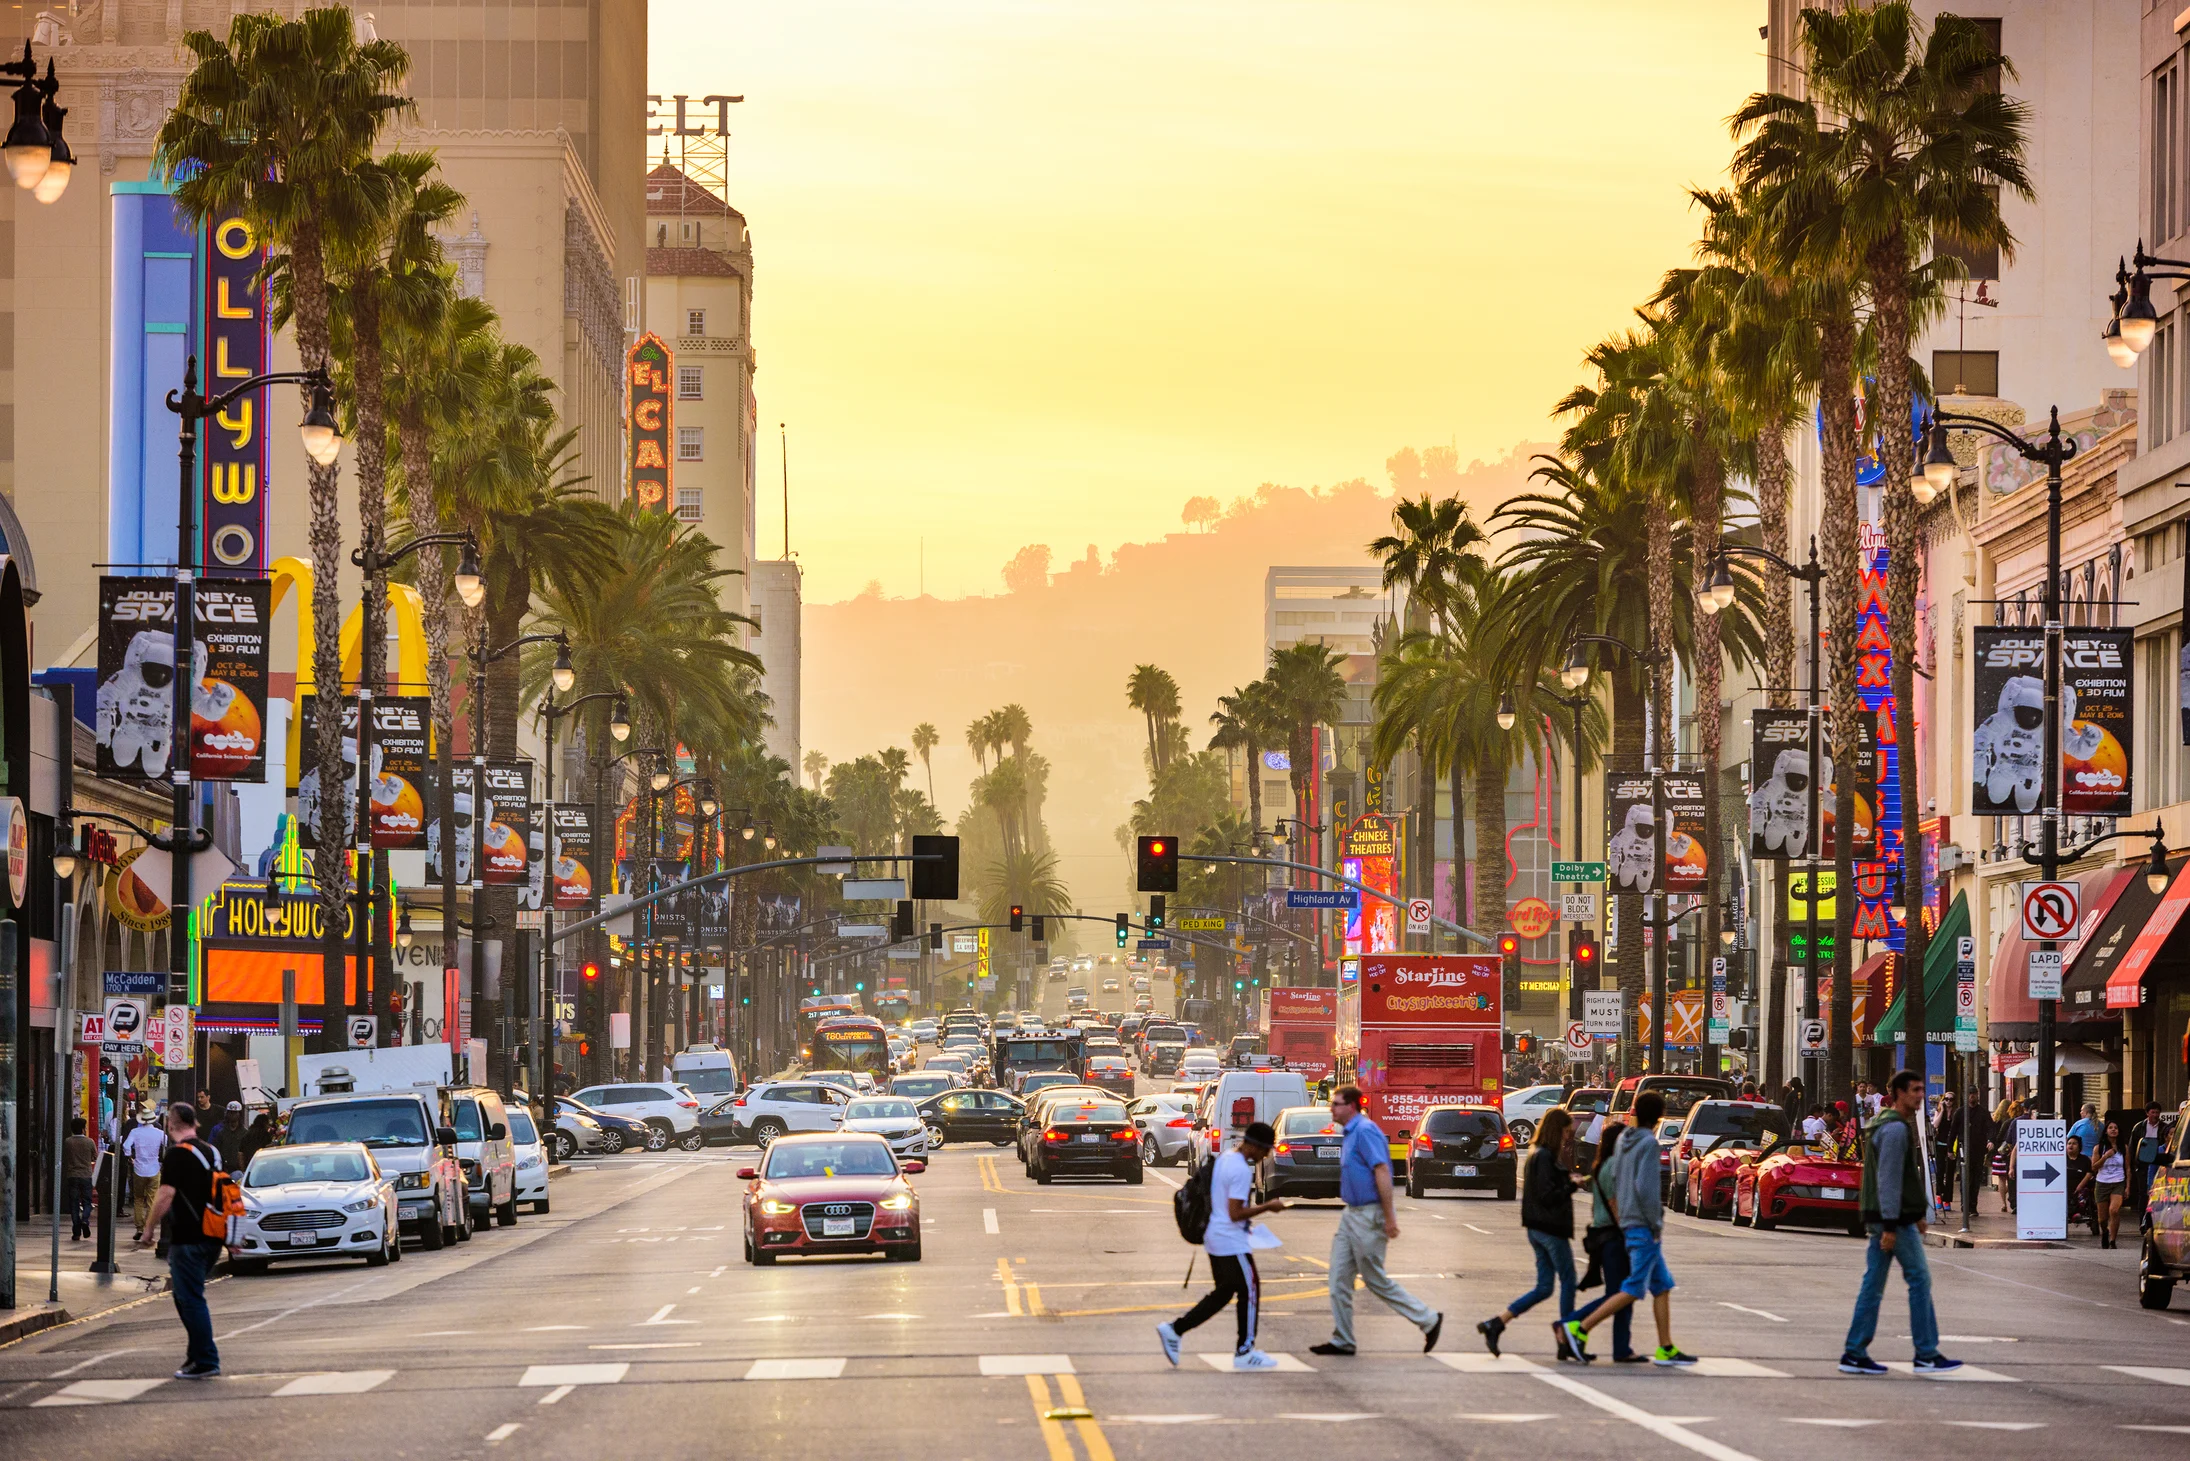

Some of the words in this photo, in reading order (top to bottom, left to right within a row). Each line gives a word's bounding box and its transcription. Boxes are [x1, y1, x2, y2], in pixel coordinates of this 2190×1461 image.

[646, 94, 745, 137] ELT
[641, 346, 660, 361] The
[632, 361, 669, 394] EL
[211, 216, 257, 567] OLLYWO
[633, 398, 667, 512] CAP
[117, 590, 236, 603] JOURNEY
[235, 595, 253, 603] TO
[110, 601, 259, 624] SPACE
[1856, 567, 1890, 690] WAX
[206, 634, 262, 644] EXHIBITION
[208, 645, 216, 653] &
[217, 644, 235, 653] 3D
[235, 645, 260, 655] FILM
[1990, 639, 2101, 650] JOURNEY
[1984, 649, 2123, 669] SPACE
[210, 669, 228, 677] MAY
[239, 670, 259, 678] 2016
[2075, 678, 2127, 688] EXHIBITION
[2076, 689, 2084, 697] &
[2085, 688, 2102, 697] 3D
[2102, 688, 2125, 698] FILM
[340, 706, 404, 715] URNEY
[2079, 711, 2096, 719] MAY
[2106, 711, 2125, 719] 2016
[381, 738, 424, 747] EXHIBITION
[404, 746, 423, 755] FILM
[195, 752, 223, 760] California
[223, 753, 243, 761] Science
[451, 768, 511, 777] URNEY
[1615, 786, 1704, 799] SPACE
[2068, 789, 2094, 797] California
[492, 794, 527, 802] EXHIBITION
[511, 801, 527, 809] FILM
[529, 815, 589, 827] PACE
[1362, 818, 1379, 829] TCL
[1352, 830, 1389, 842] CHINESE
[1349, 843, 1392, 855] THEATRES
[1559, 864, 1585, 873] Dolby
[1554, 872, 1591, 880] Theatre
[1817, 876, 1836, 886] ESSIO
[1292, 894, 1335, 906] Highland
[1338, 894, 1351, 904] Av
[1565, 896, 1576, 904] DO
[1578, 896, 1591, 904] NOT
[1505, 905, 1529, 921] ard
[1567, 905, 1590, 913] BLOCK
[117, 911, 147, 930] Since
[150, 912, 172, 931] 1989
[228, 897, 355, 940] HOLYWOD
[1182, 920, 1200, 928] PED
[1202, 920, 1223, 928] XING
[1416, 923, 1429, 931] RED
[979, 932, 988, 972] INN
[2031, 954, 2060, 964] LAPD
[1378, 968, 1387, 976] Off
[105, 973, 156, 985] McCadden
[105, 984, 122, 992] 1700
[124, 984, 130, 992] N
[1519, 981, 1529, 991] ST
[667, 987, 675, 1019] ZARA
[807, 1011, 817, 1019] 217
[1590, 1008, 1620, 1016] MUST
[84, 1017, 104, 1034] AT
[147, 1018, 164, 1034] AT
[1605, 1020, 1621, 1028] RIGH
[824, 1032, 841, 1041] 780
[1893, 1031, 1906, 1041] CAM
[104, 1043, 118, 1052] PAY
[120, 1044, 141, 1053] HERE
[1569, 1050, 1579, 1058] ON
[1579, 1050, 1592, 1058] RED
[1381, 1094, 1484, 1105] 1-855-4LAHOPON
[1381, 1114, 1422, 1123] www.CityS
[2018, 1127, 2064, 1139] PUBLIC
[2018, 1140, 2065, 1152] PARKING
